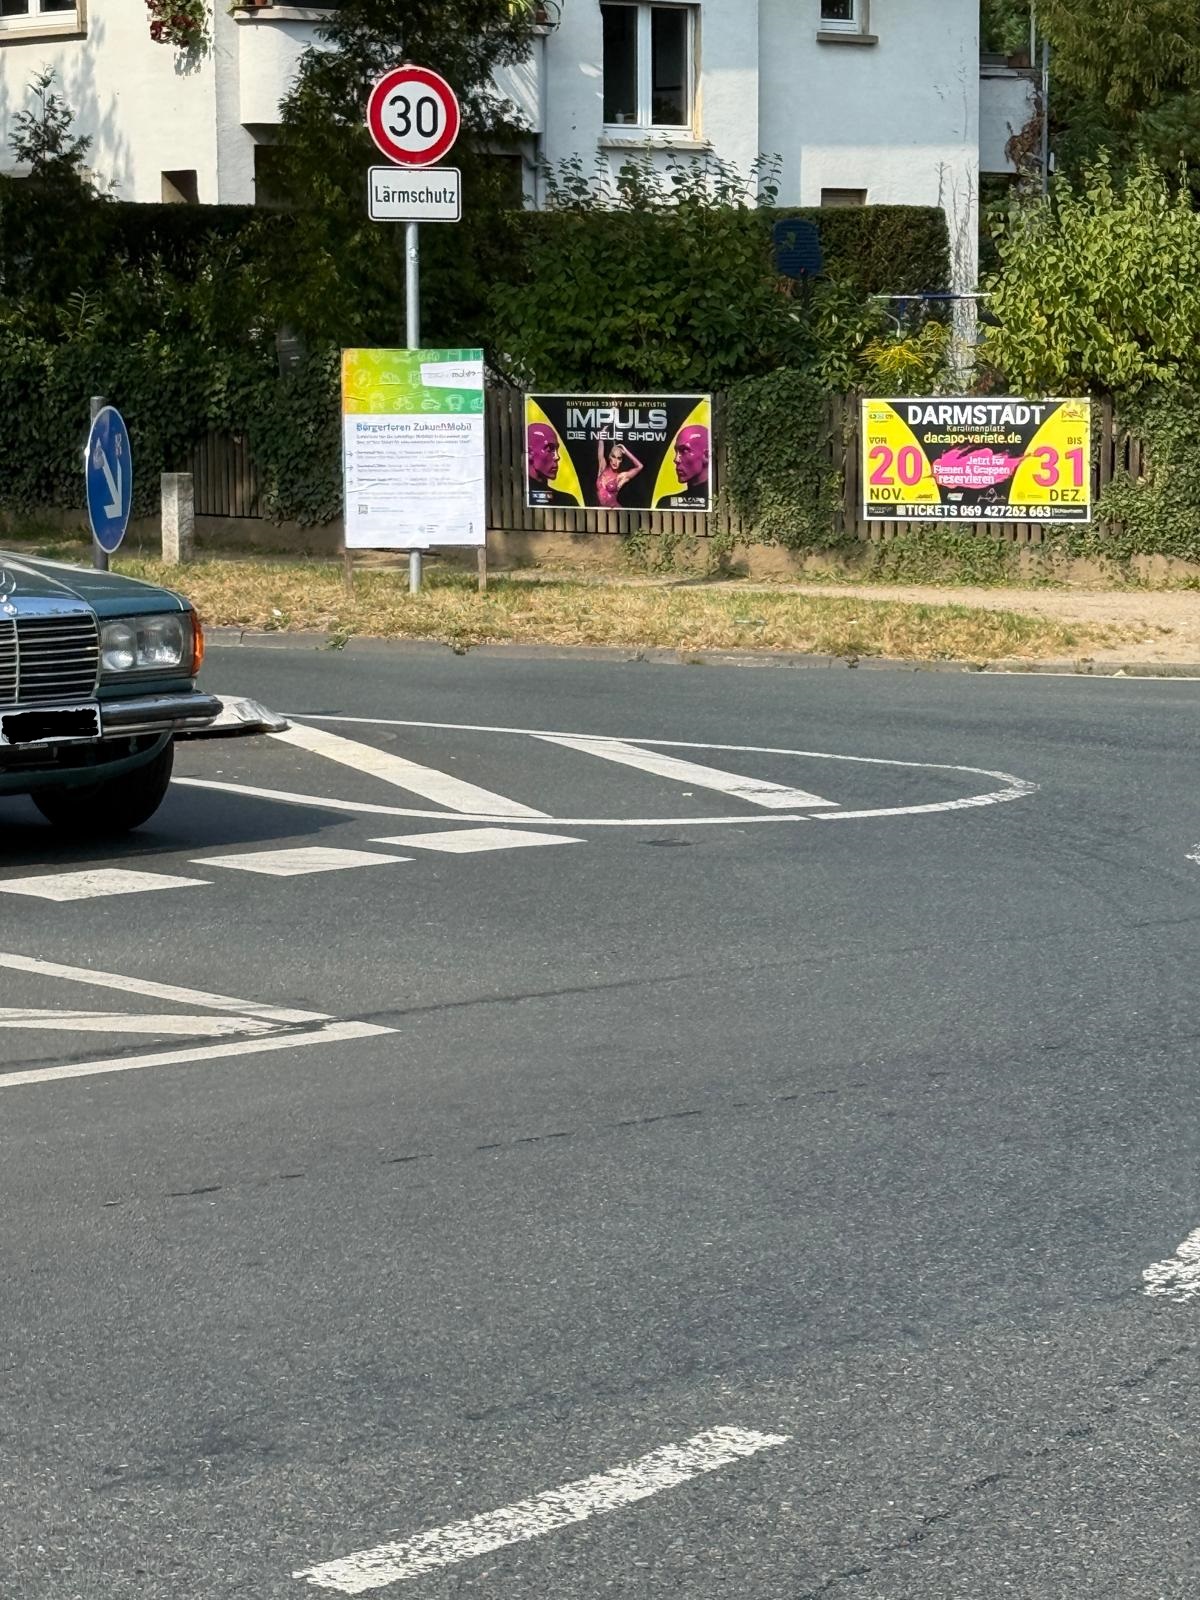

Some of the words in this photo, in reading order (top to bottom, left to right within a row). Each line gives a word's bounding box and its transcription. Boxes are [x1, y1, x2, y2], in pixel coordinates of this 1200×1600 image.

[389, 95, 438, 138] 30
[375, 185, 456, 204] Lärmschutz
[566, 408, 668, 430] IMPULS
[907, 405, 1046, 426] DARMSTADT
[566, 431, 586, 441] DIE
[590, 431, 624, 441] NEUE
[628, 431, 667, 442] SHOW
[868, 437, 887, 445] VON
[923, 432, 1022, 445] dacapo-variete.de
[1067, 436, 1083, 445] BIS
[869, 445, 923, 486] 20
[966, 456, 990, 465] Jetzt
[1032, 445, 1084, 487] 31
[965, 466, 973, 474] &
[870, 488, 904, 500] NOV.
[1049, 489, 1086, 502] DEZ.
[906, 504, 958, 516] TICKETS
